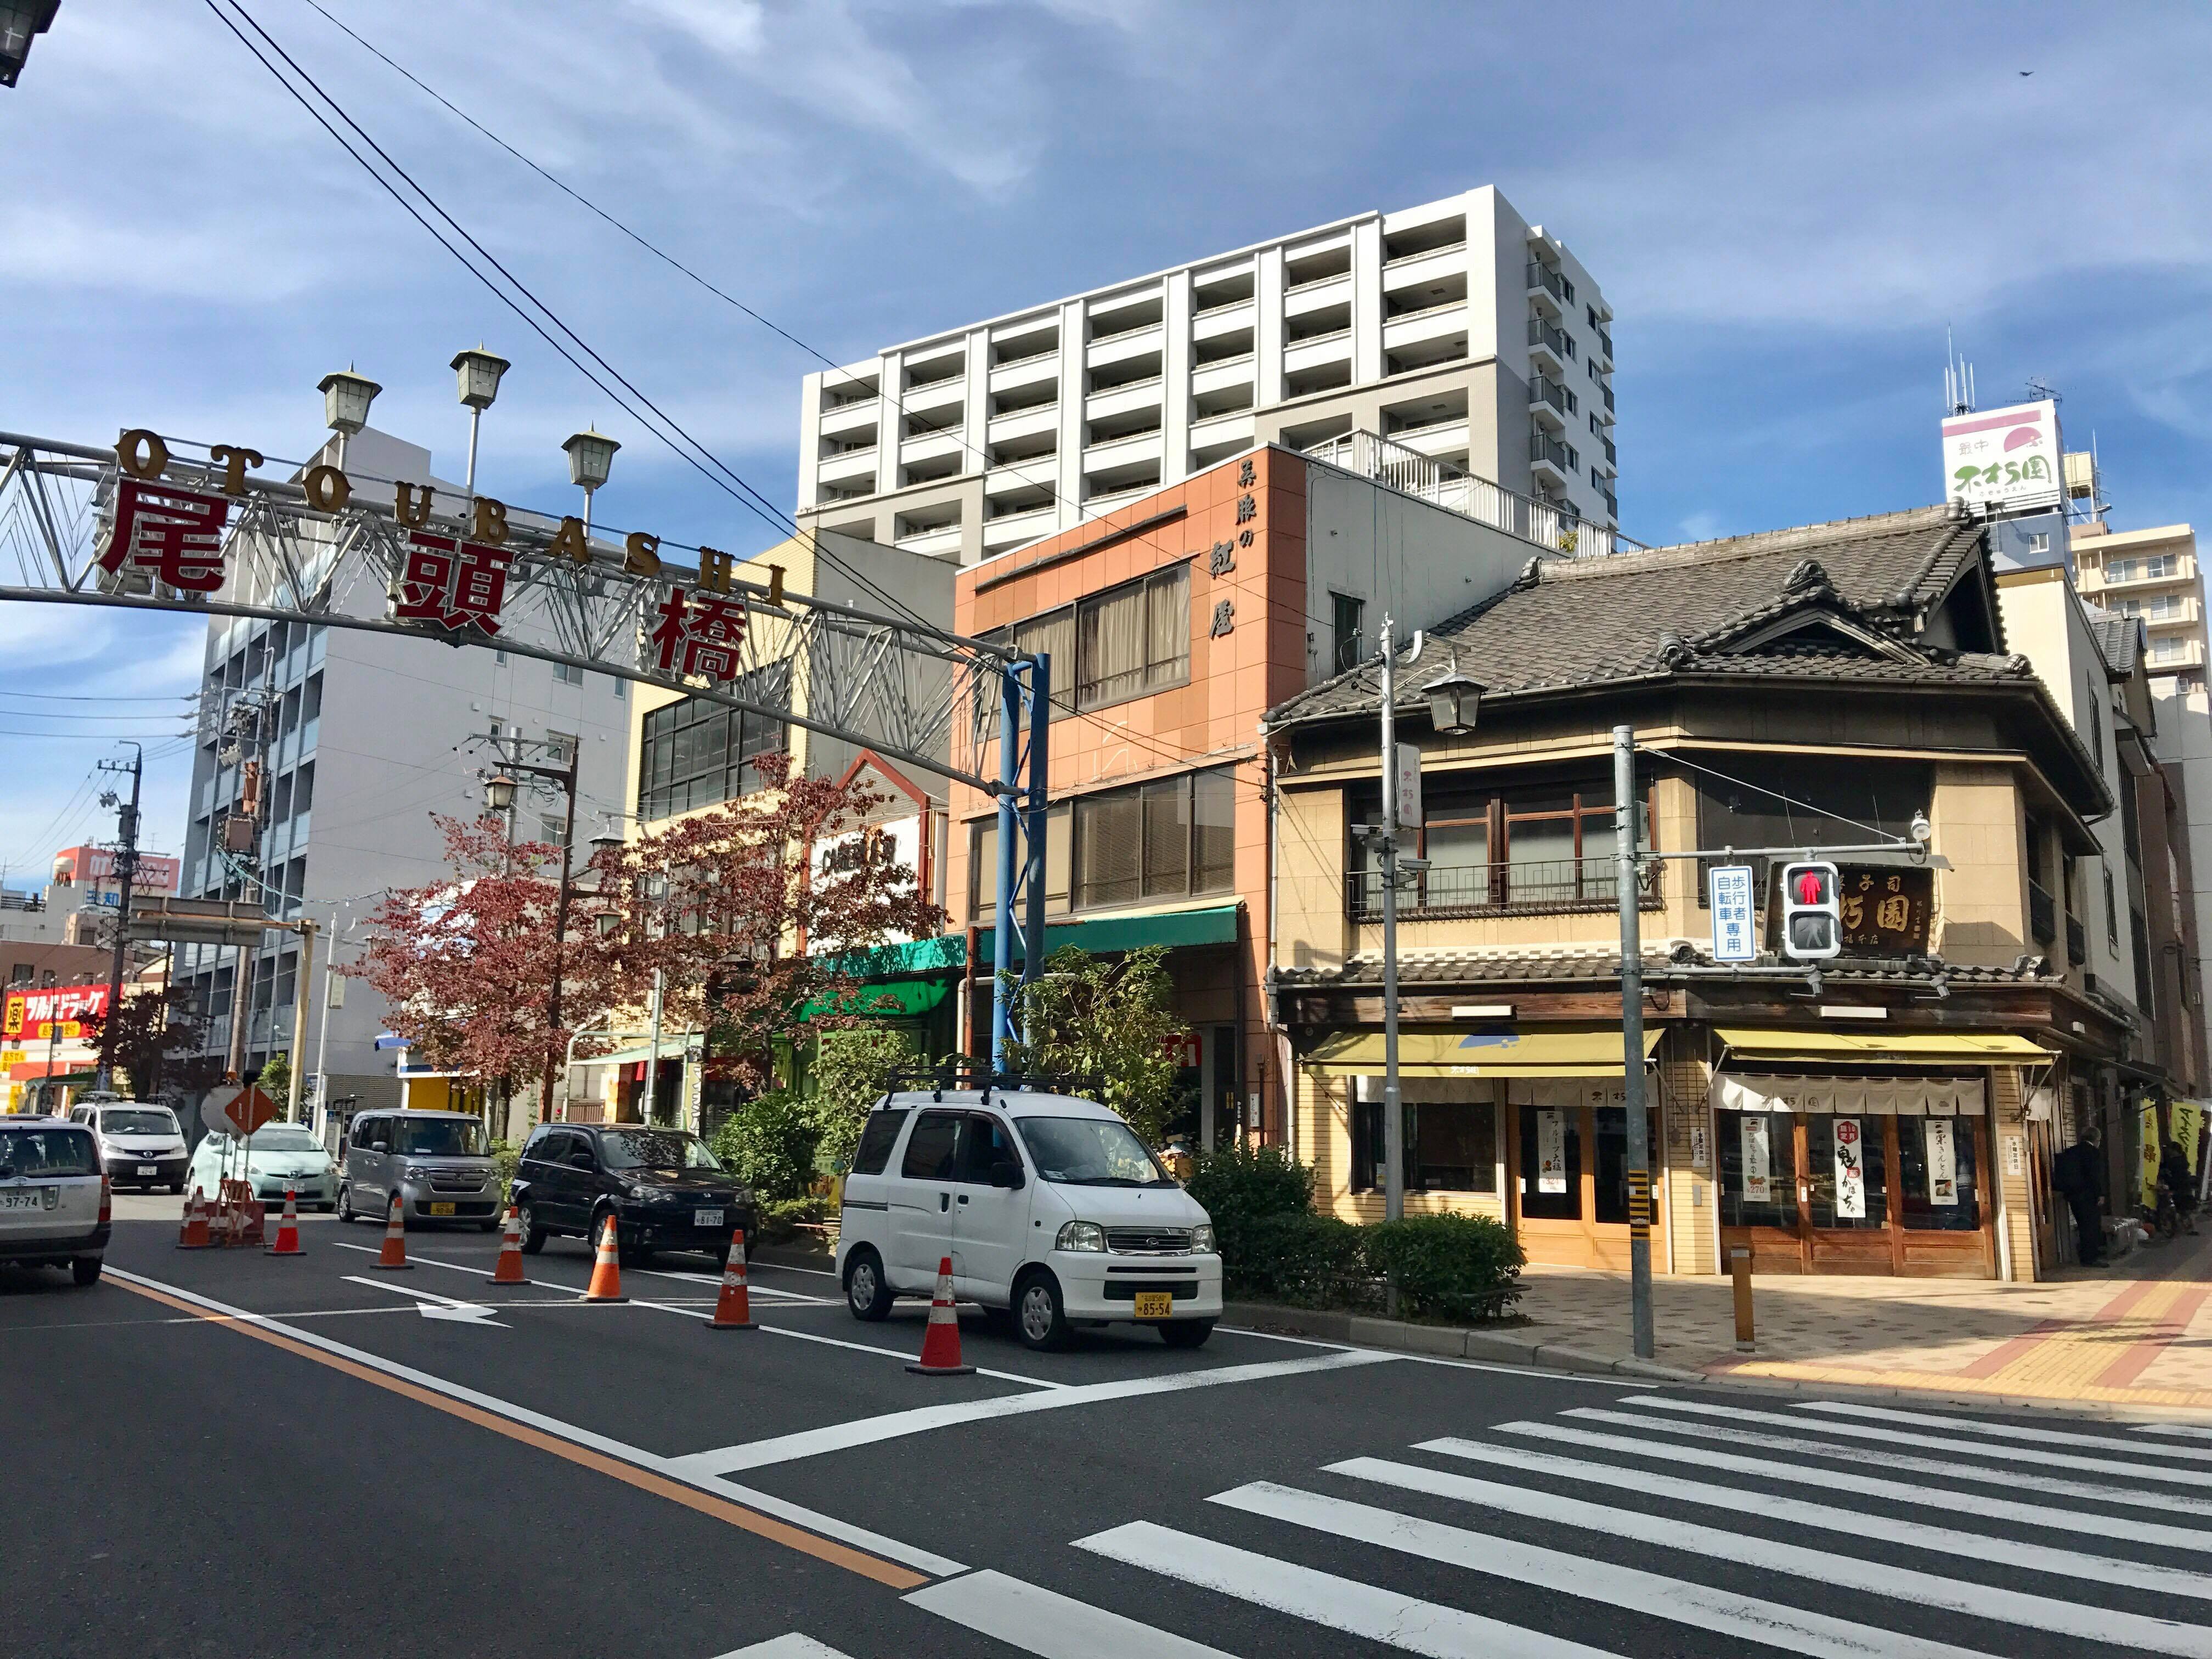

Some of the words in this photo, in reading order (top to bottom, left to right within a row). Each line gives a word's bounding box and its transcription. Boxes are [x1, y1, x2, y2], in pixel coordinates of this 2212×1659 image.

[1959, 439, 1989, 456] 最中
[113, 428, 786, 608] OTOUBASHI
[97, 479, 749, 690] 尾頭橋
[1209, 539, 1235, 640] 紅屋
[1718, 876, 1733, 921] 自転車
[1731, 876, 1747, 921] 歩行者
[1726, 922, 1741, 952] 専用
[8, 1002, 22, 1031] 薬
[5, 1197, 38, 1208] 97-74
[701, 1216, 722, 1224] 81-70
[1143, 1302, 1170, 1316] 85-54
